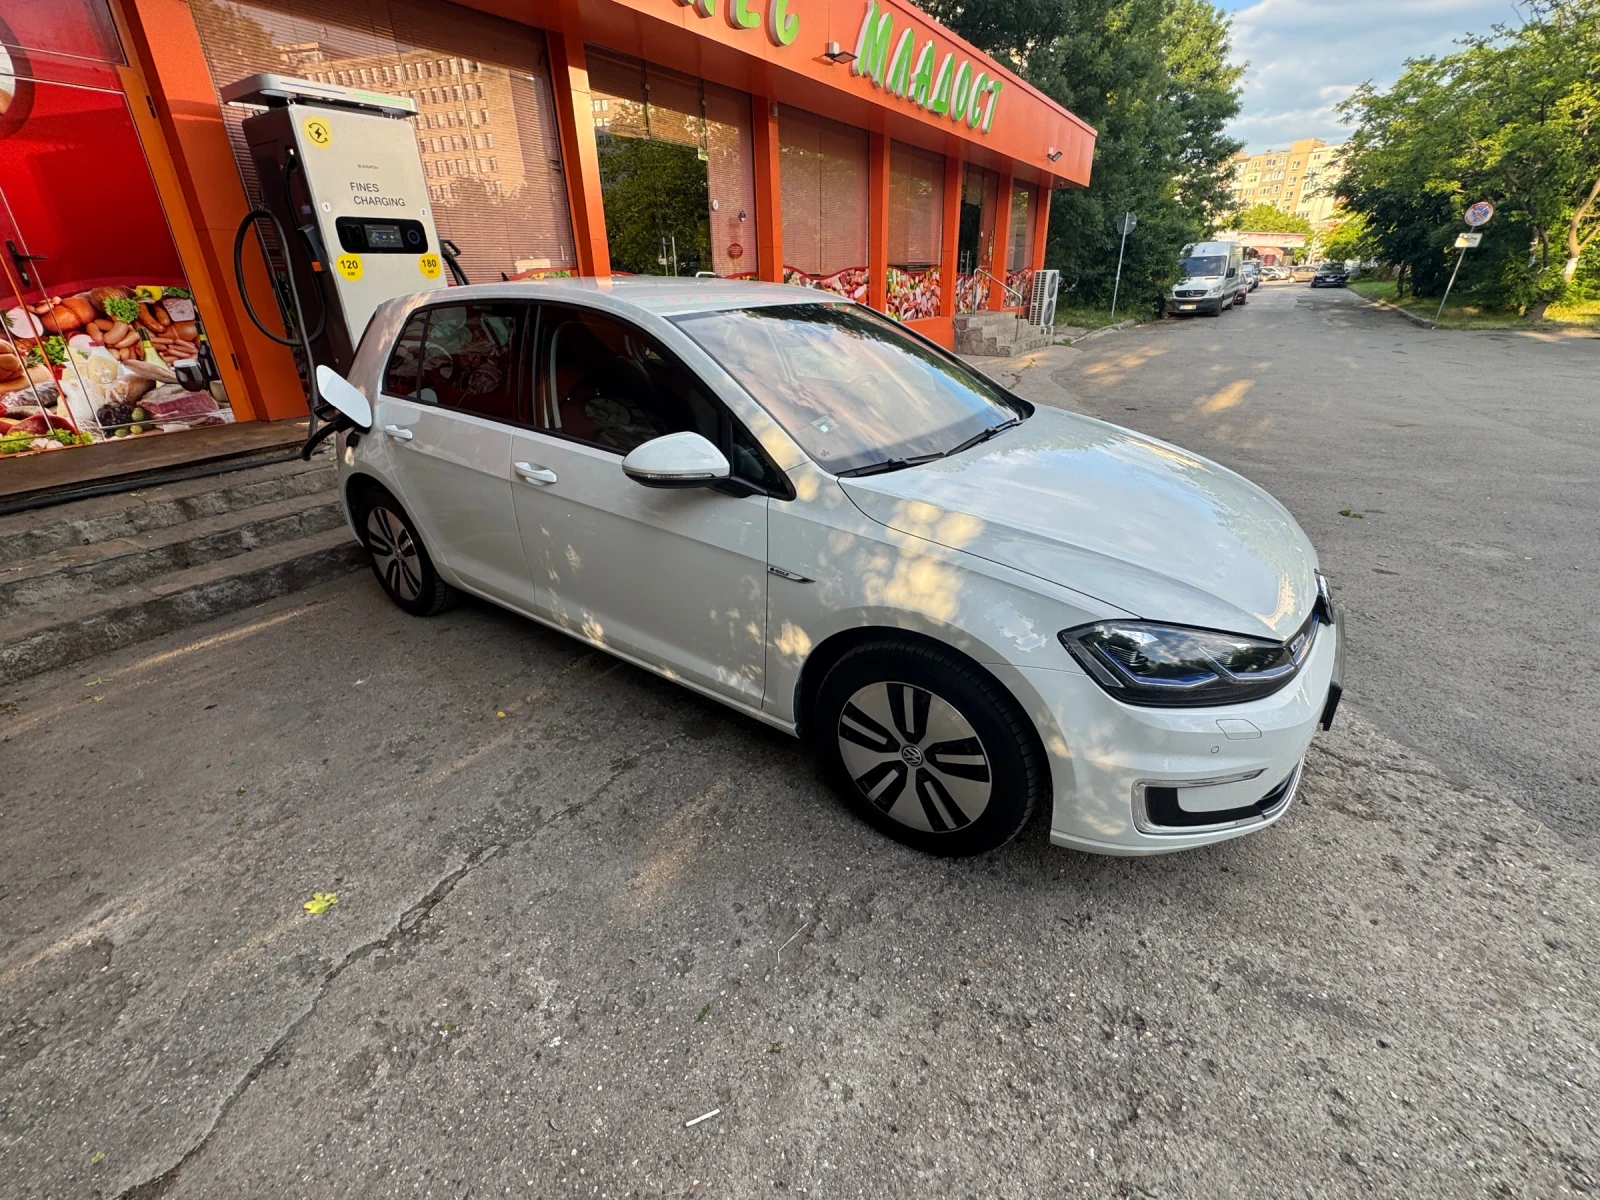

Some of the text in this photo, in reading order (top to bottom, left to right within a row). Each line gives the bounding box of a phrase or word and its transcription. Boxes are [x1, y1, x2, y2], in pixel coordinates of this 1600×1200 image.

[853, 0, 1003, 134] МЛАДОСТ
[349, 182, 379, 192] FINES
[353, 195, 405, 206] CHARGING
[341, 260, 358, 269] 120
[422, 259, 437, 268] 180
